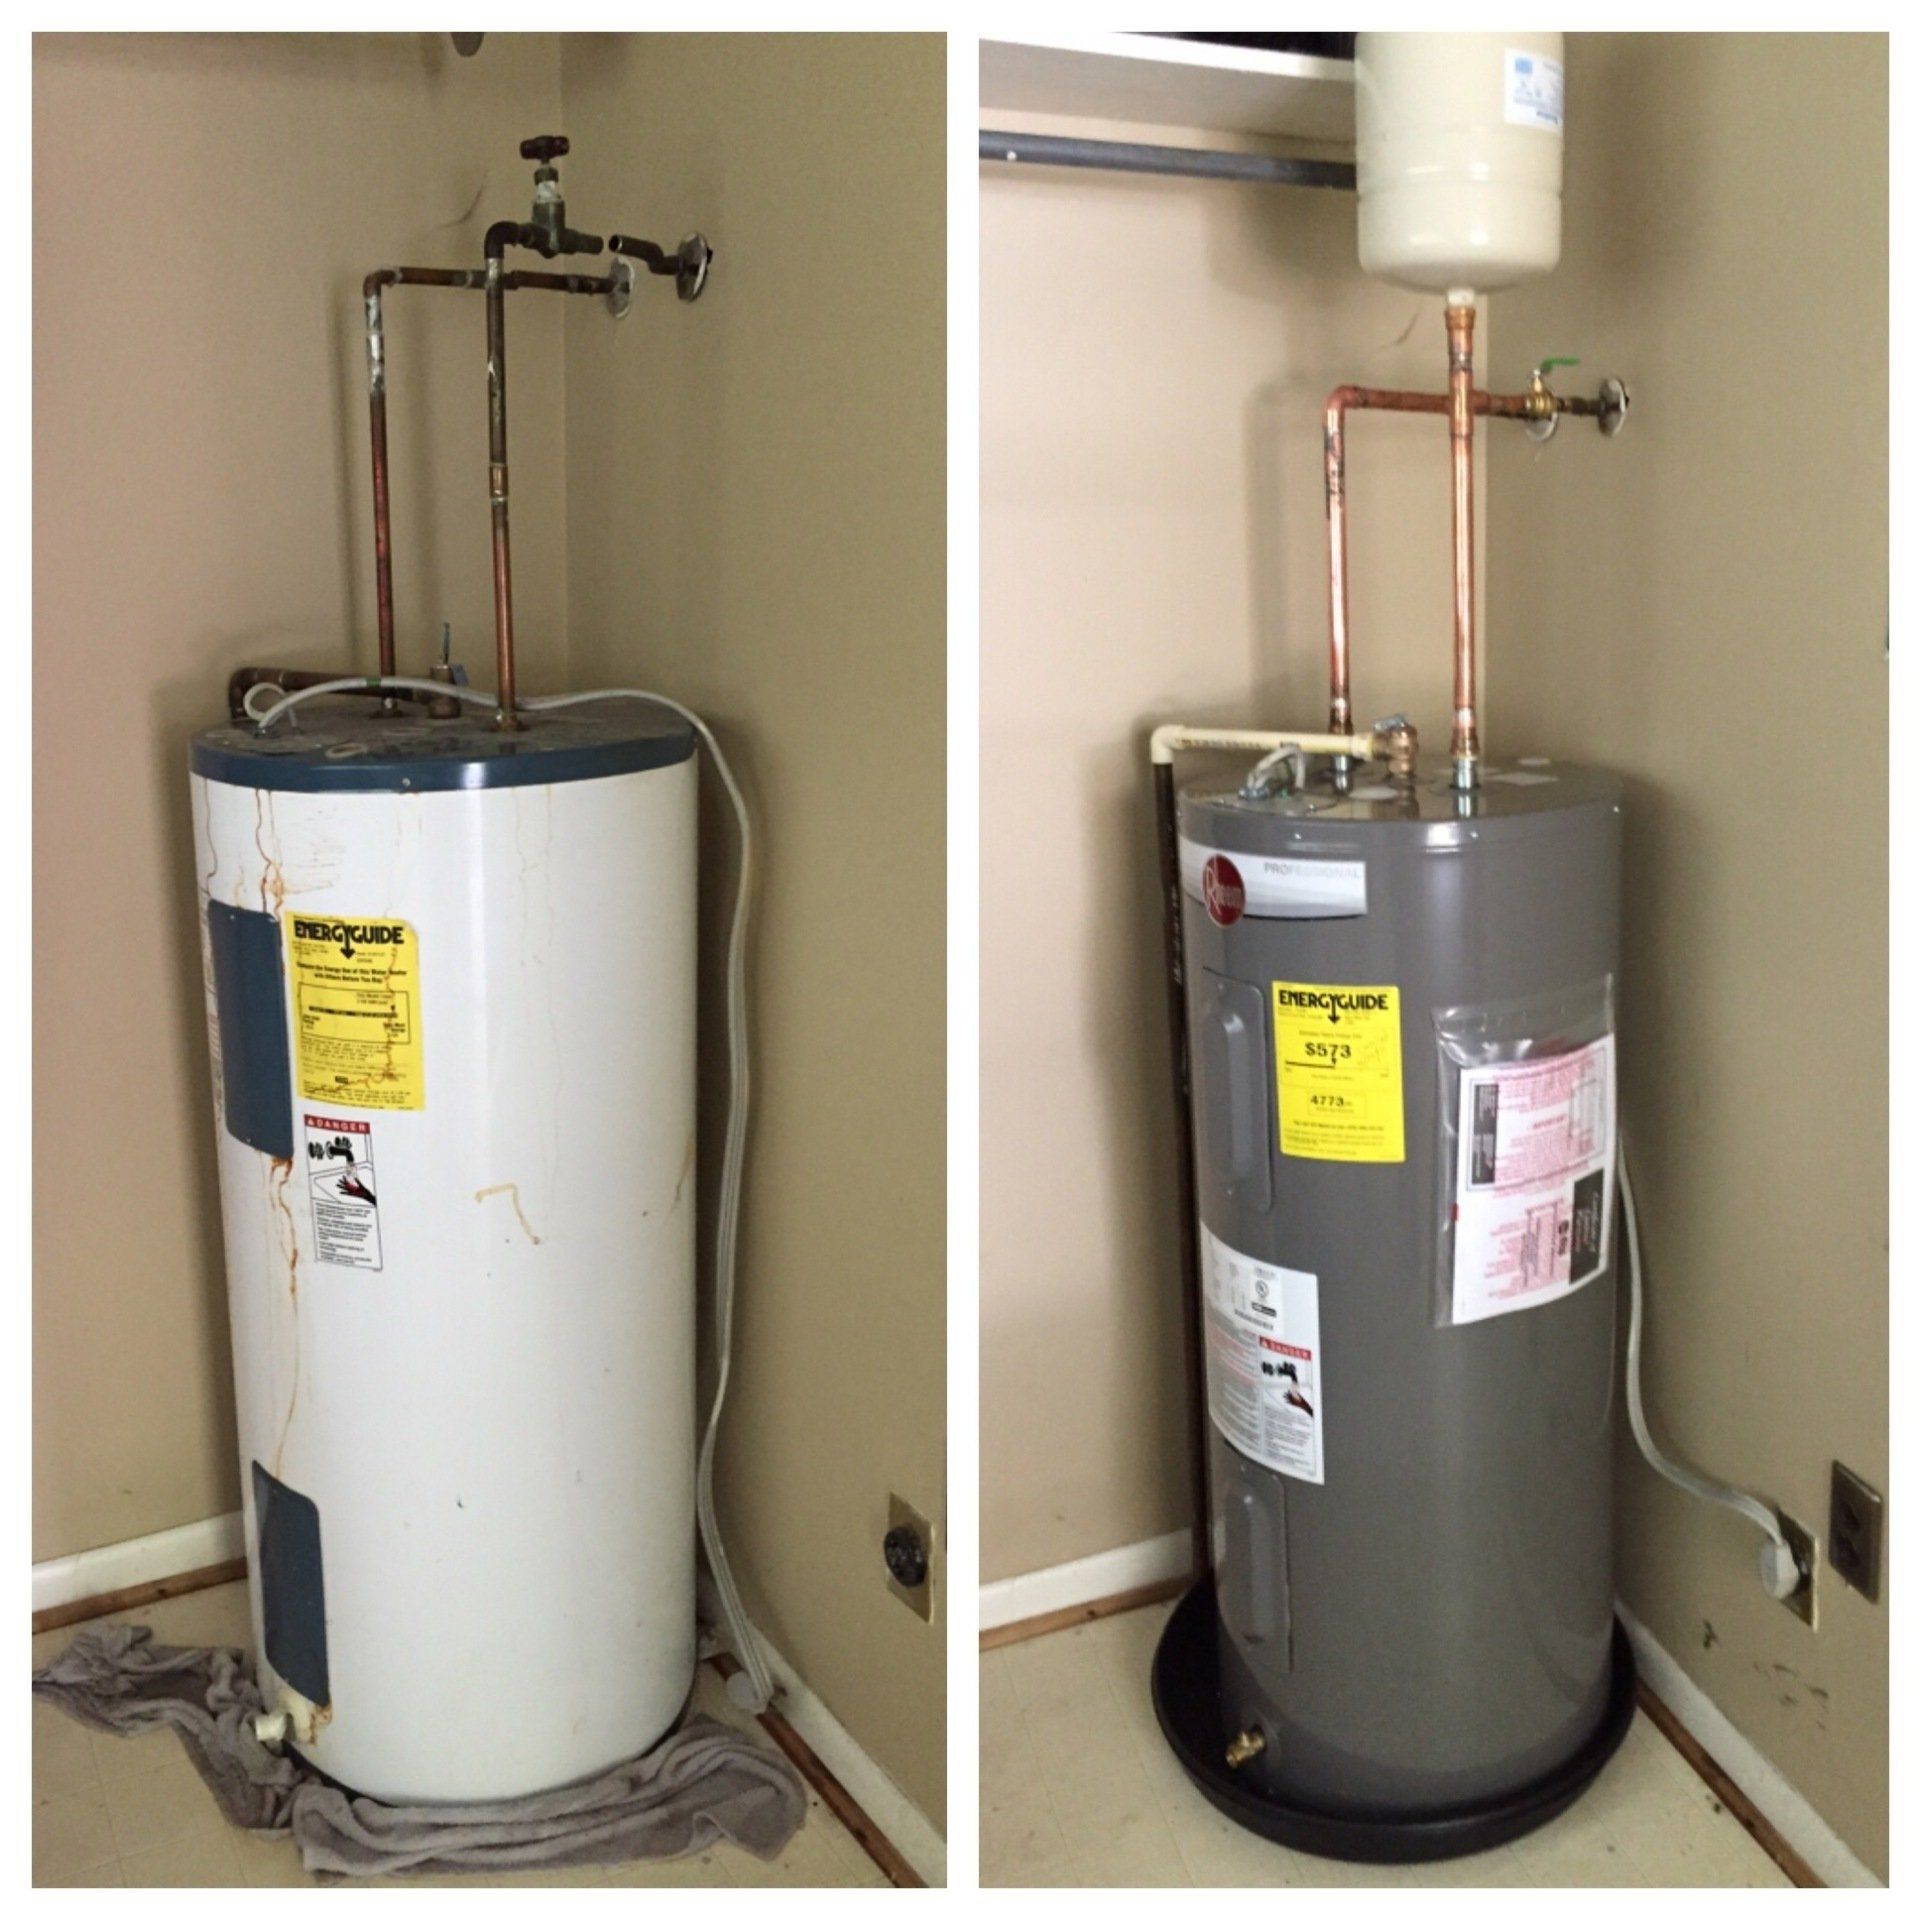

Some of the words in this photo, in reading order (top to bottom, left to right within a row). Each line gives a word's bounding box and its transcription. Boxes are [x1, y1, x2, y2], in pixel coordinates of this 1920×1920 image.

[293, 919, 405, 945] ENERGYGUIDE
[1278, 989, 1389, 1011] ENERGYGUIDE
[1305, 1042, 1352, 1059] $573
[1310, 1094, 1345, 1108] 4773
[316, 1117, 367, 1133] DANGER
